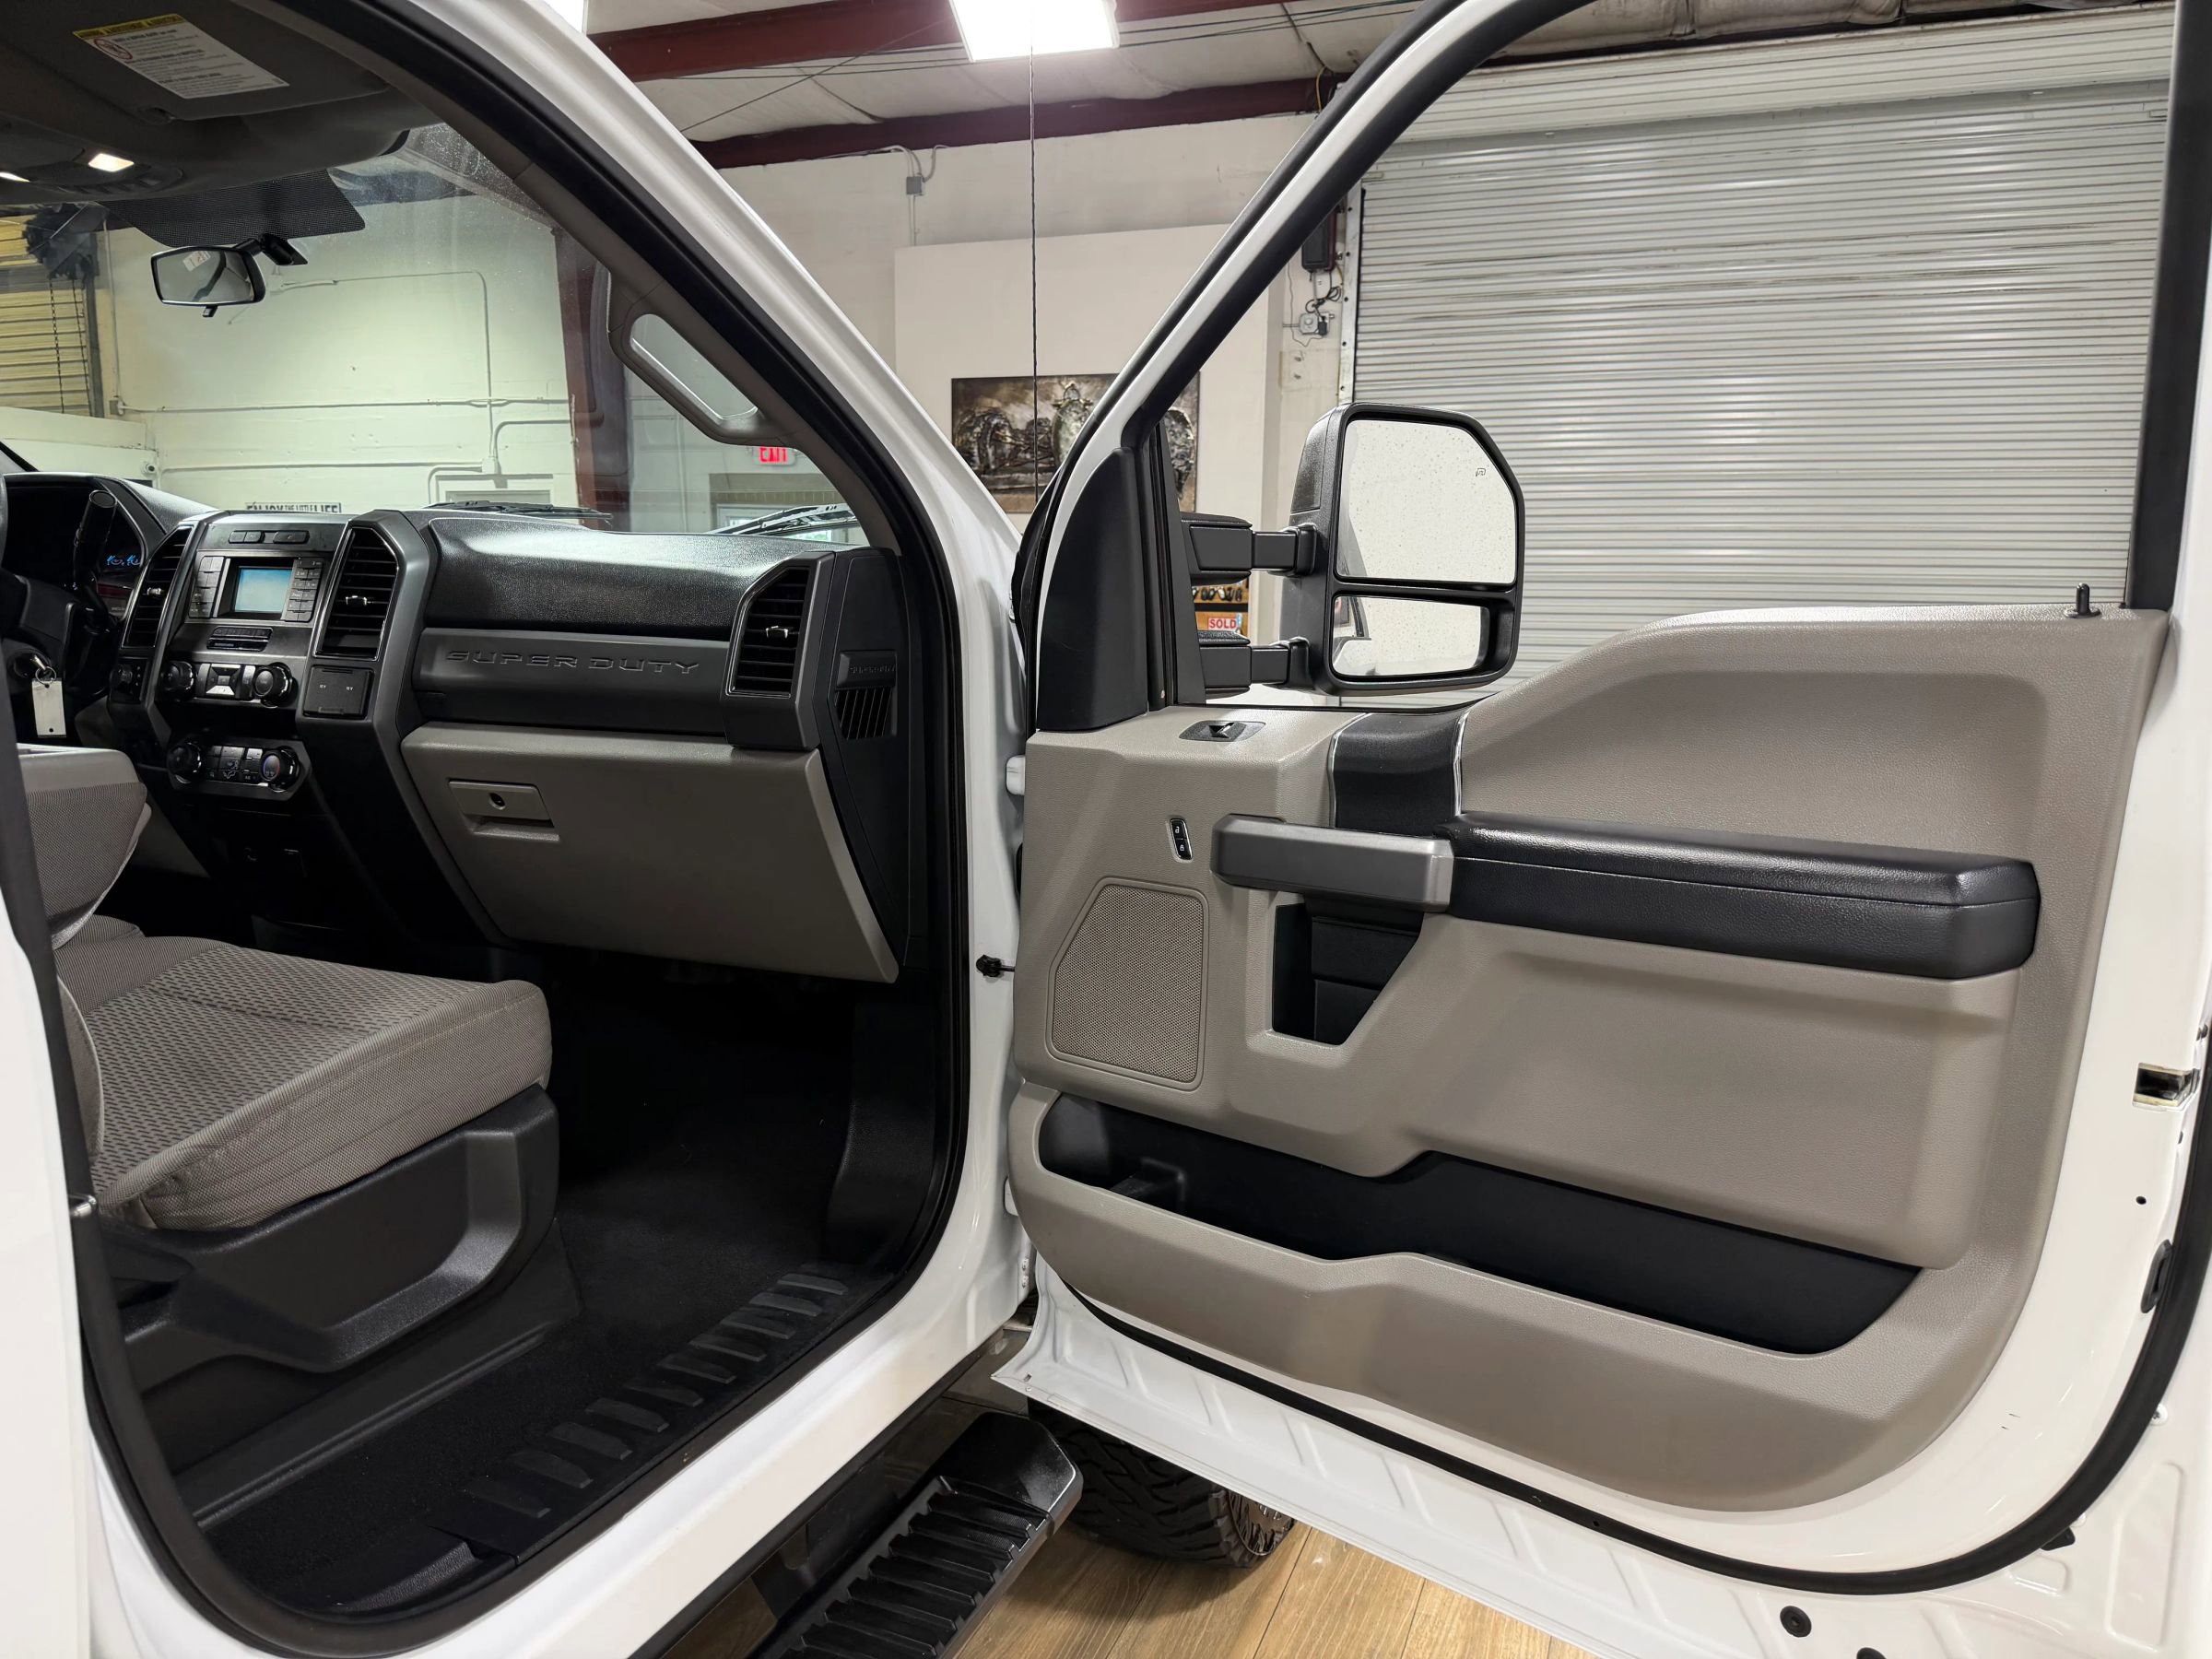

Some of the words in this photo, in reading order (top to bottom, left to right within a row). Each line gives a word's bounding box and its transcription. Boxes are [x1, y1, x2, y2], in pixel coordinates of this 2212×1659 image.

[1209, 618, 1237, 629] SOLD
[445, 650, 578, 669] SUPER
[588, 657, 700, 675] DUTY
